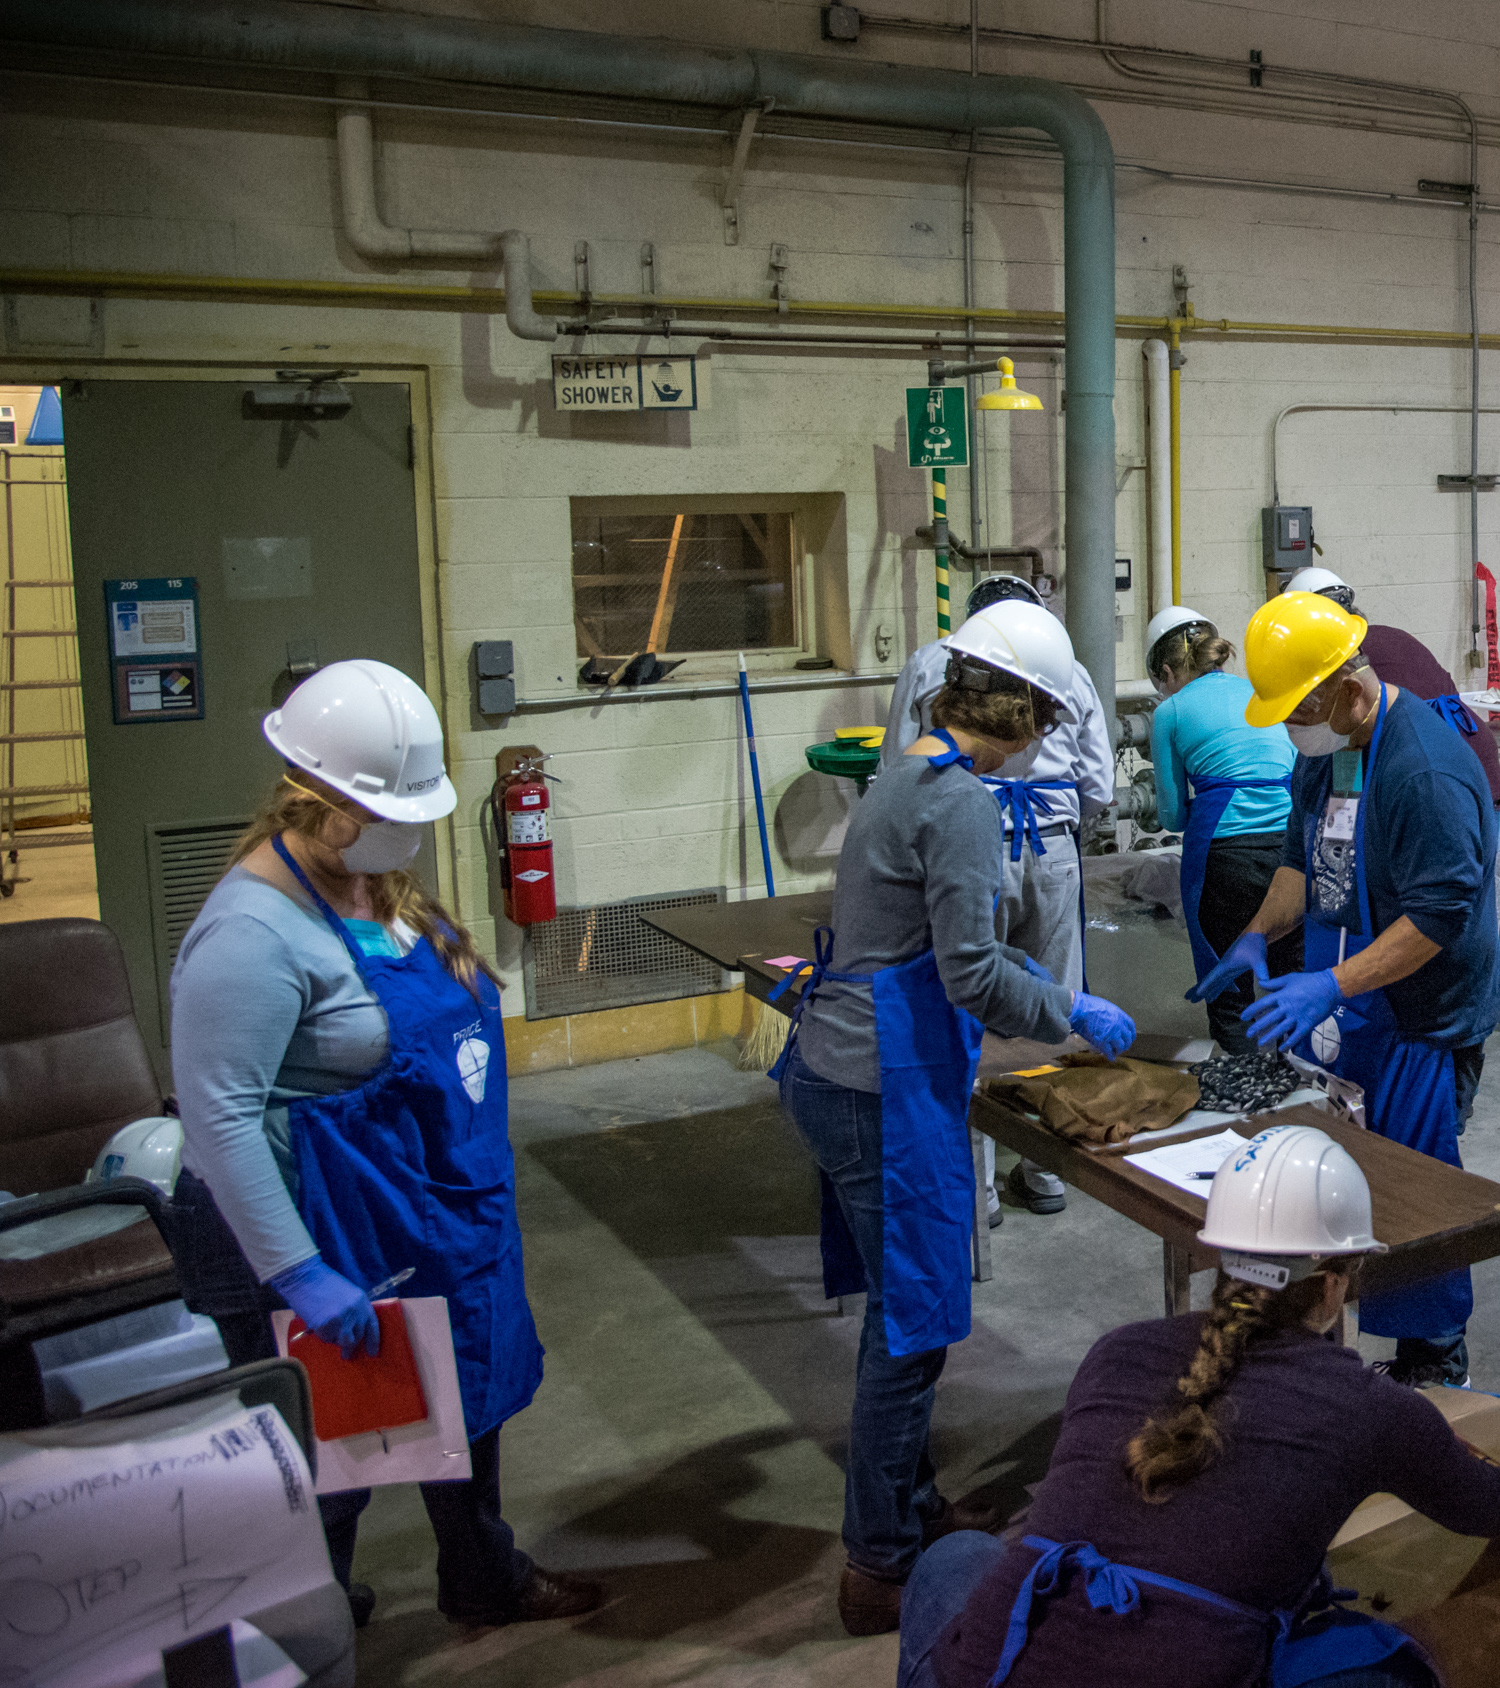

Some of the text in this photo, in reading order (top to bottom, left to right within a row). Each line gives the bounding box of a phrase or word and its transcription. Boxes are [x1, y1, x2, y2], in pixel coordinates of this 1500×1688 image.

[560, 361, 629, 379] SAFETY
[561, 386, 634, 404] SHOWER
[120, 581, 139, 591] 205
[167, 579, 183, 588] 115
[453, 1018, 482, 1045] PRICE
